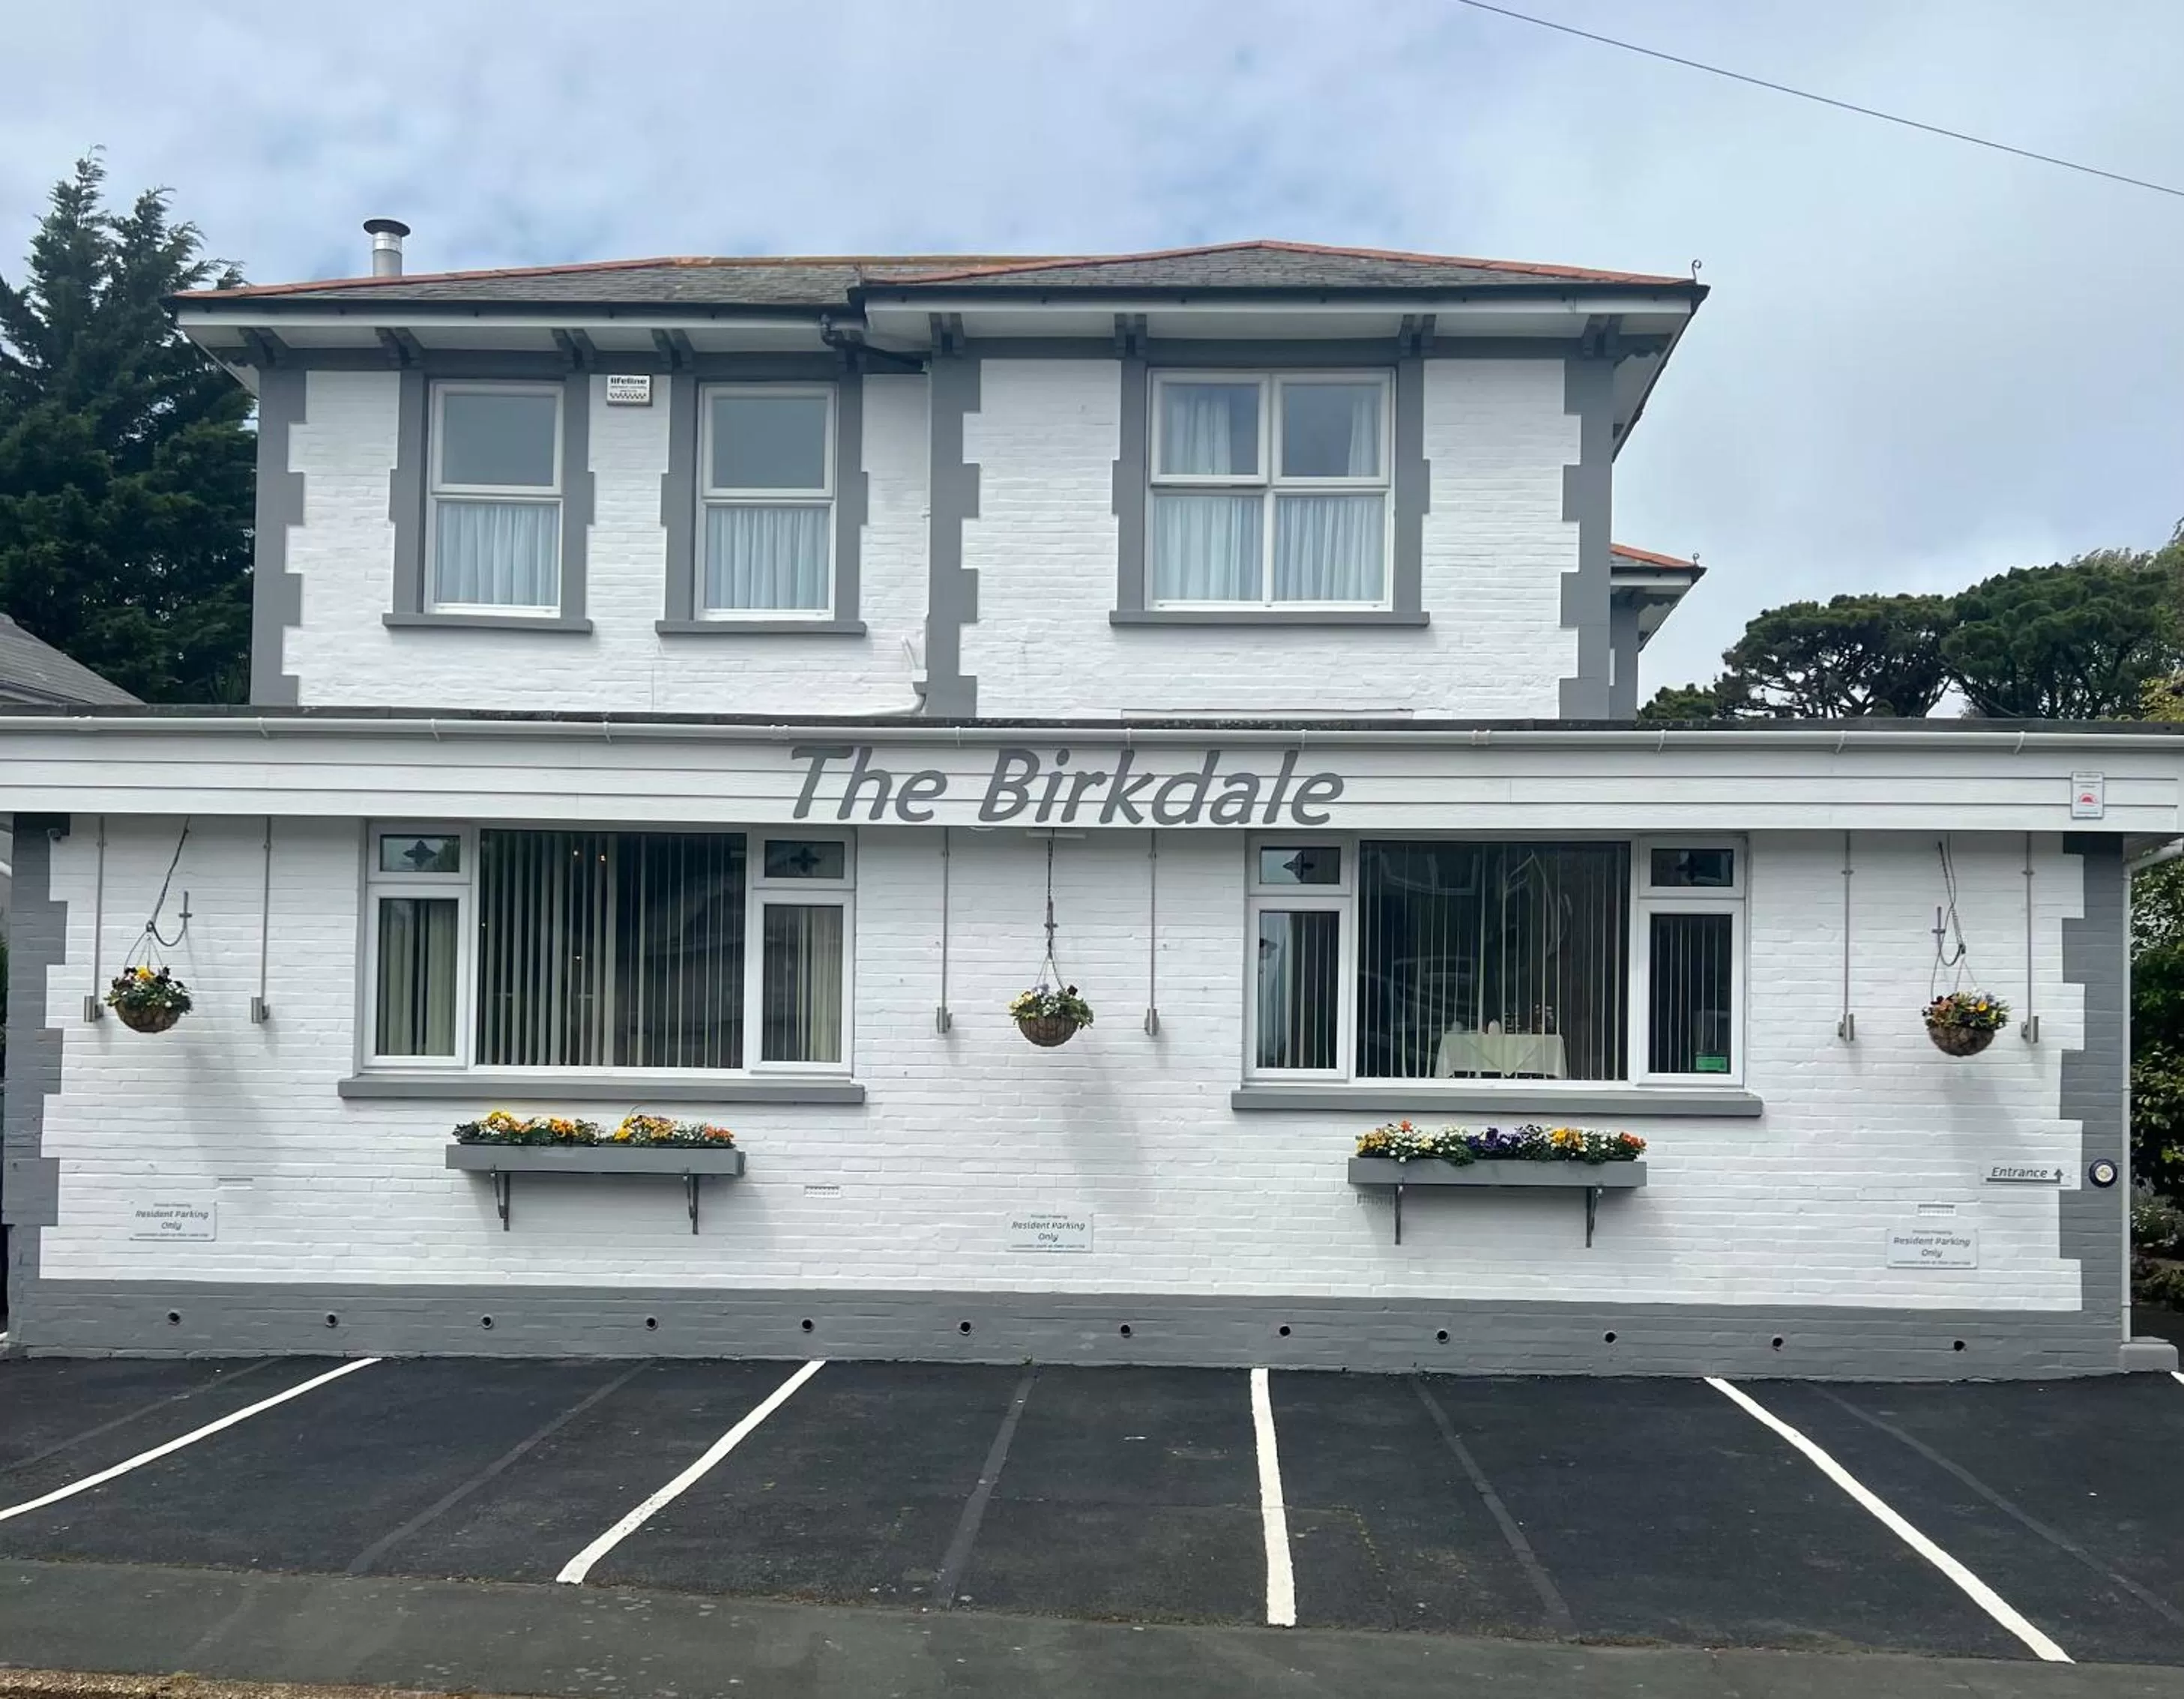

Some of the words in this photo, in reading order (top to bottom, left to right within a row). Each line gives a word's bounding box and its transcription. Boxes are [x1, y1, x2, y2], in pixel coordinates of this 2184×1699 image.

[791, 746, 948, 822] The
[977, 748, 1345, 825] Birkdale
[1991, 1167, 2048, 1178] Entrance
[135, 1210, 174, 1218] Resident
[174, 1210, 209, 1220] Parking
[160, 1221, 183, 1231] Only
[1011, 1221, 1050, 1230] Resident
[1051, 1221, 1085, 1231] Parking
[1037, 1232, 1059, 1243] Only
[1893, 1237, 1934, 1245] Resident
[1934, 1237, 1971, 1248] Parking
[1921, 1249, 1943, 1259] Only
